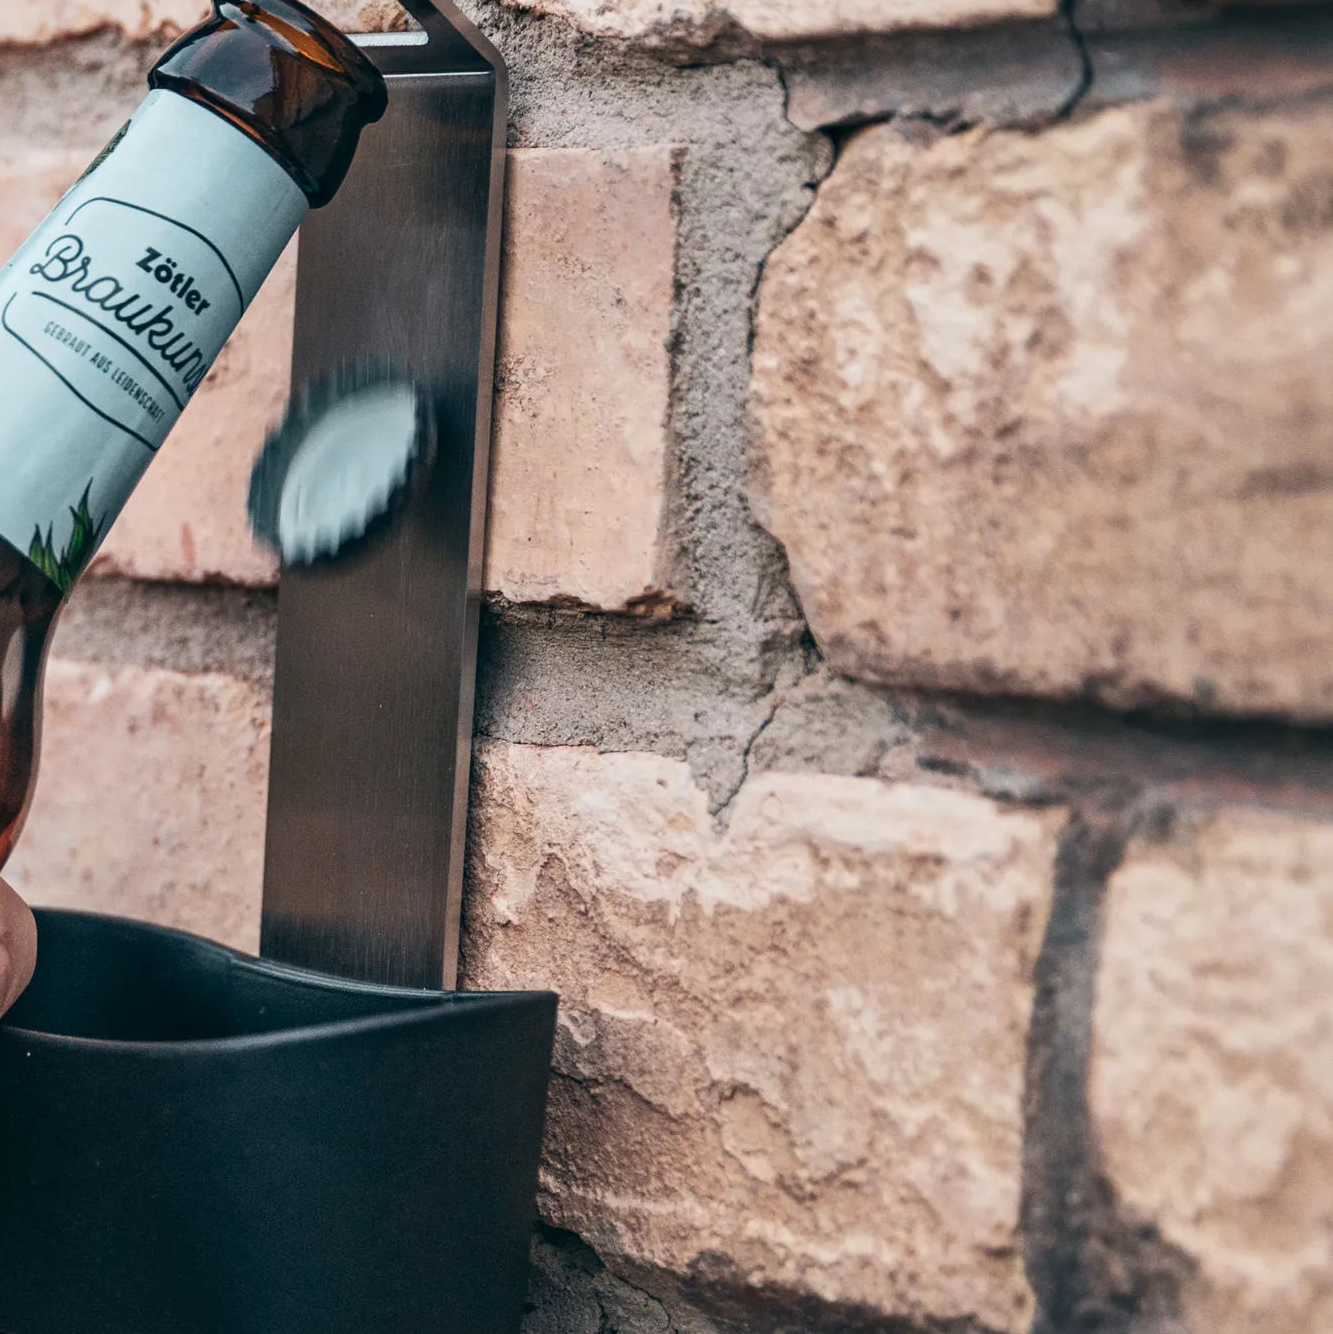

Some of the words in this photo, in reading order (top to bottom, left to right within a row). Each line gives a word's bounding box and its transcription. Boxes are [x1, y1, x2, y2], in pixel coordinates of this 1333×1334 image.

[135, 246, 211, 316] Zötler
[43, 320, 92, 358] GEBRAUT
[89, 351, 113, 374] AUS
[108, 367, 166, 424] LEIDENSCHAFT
